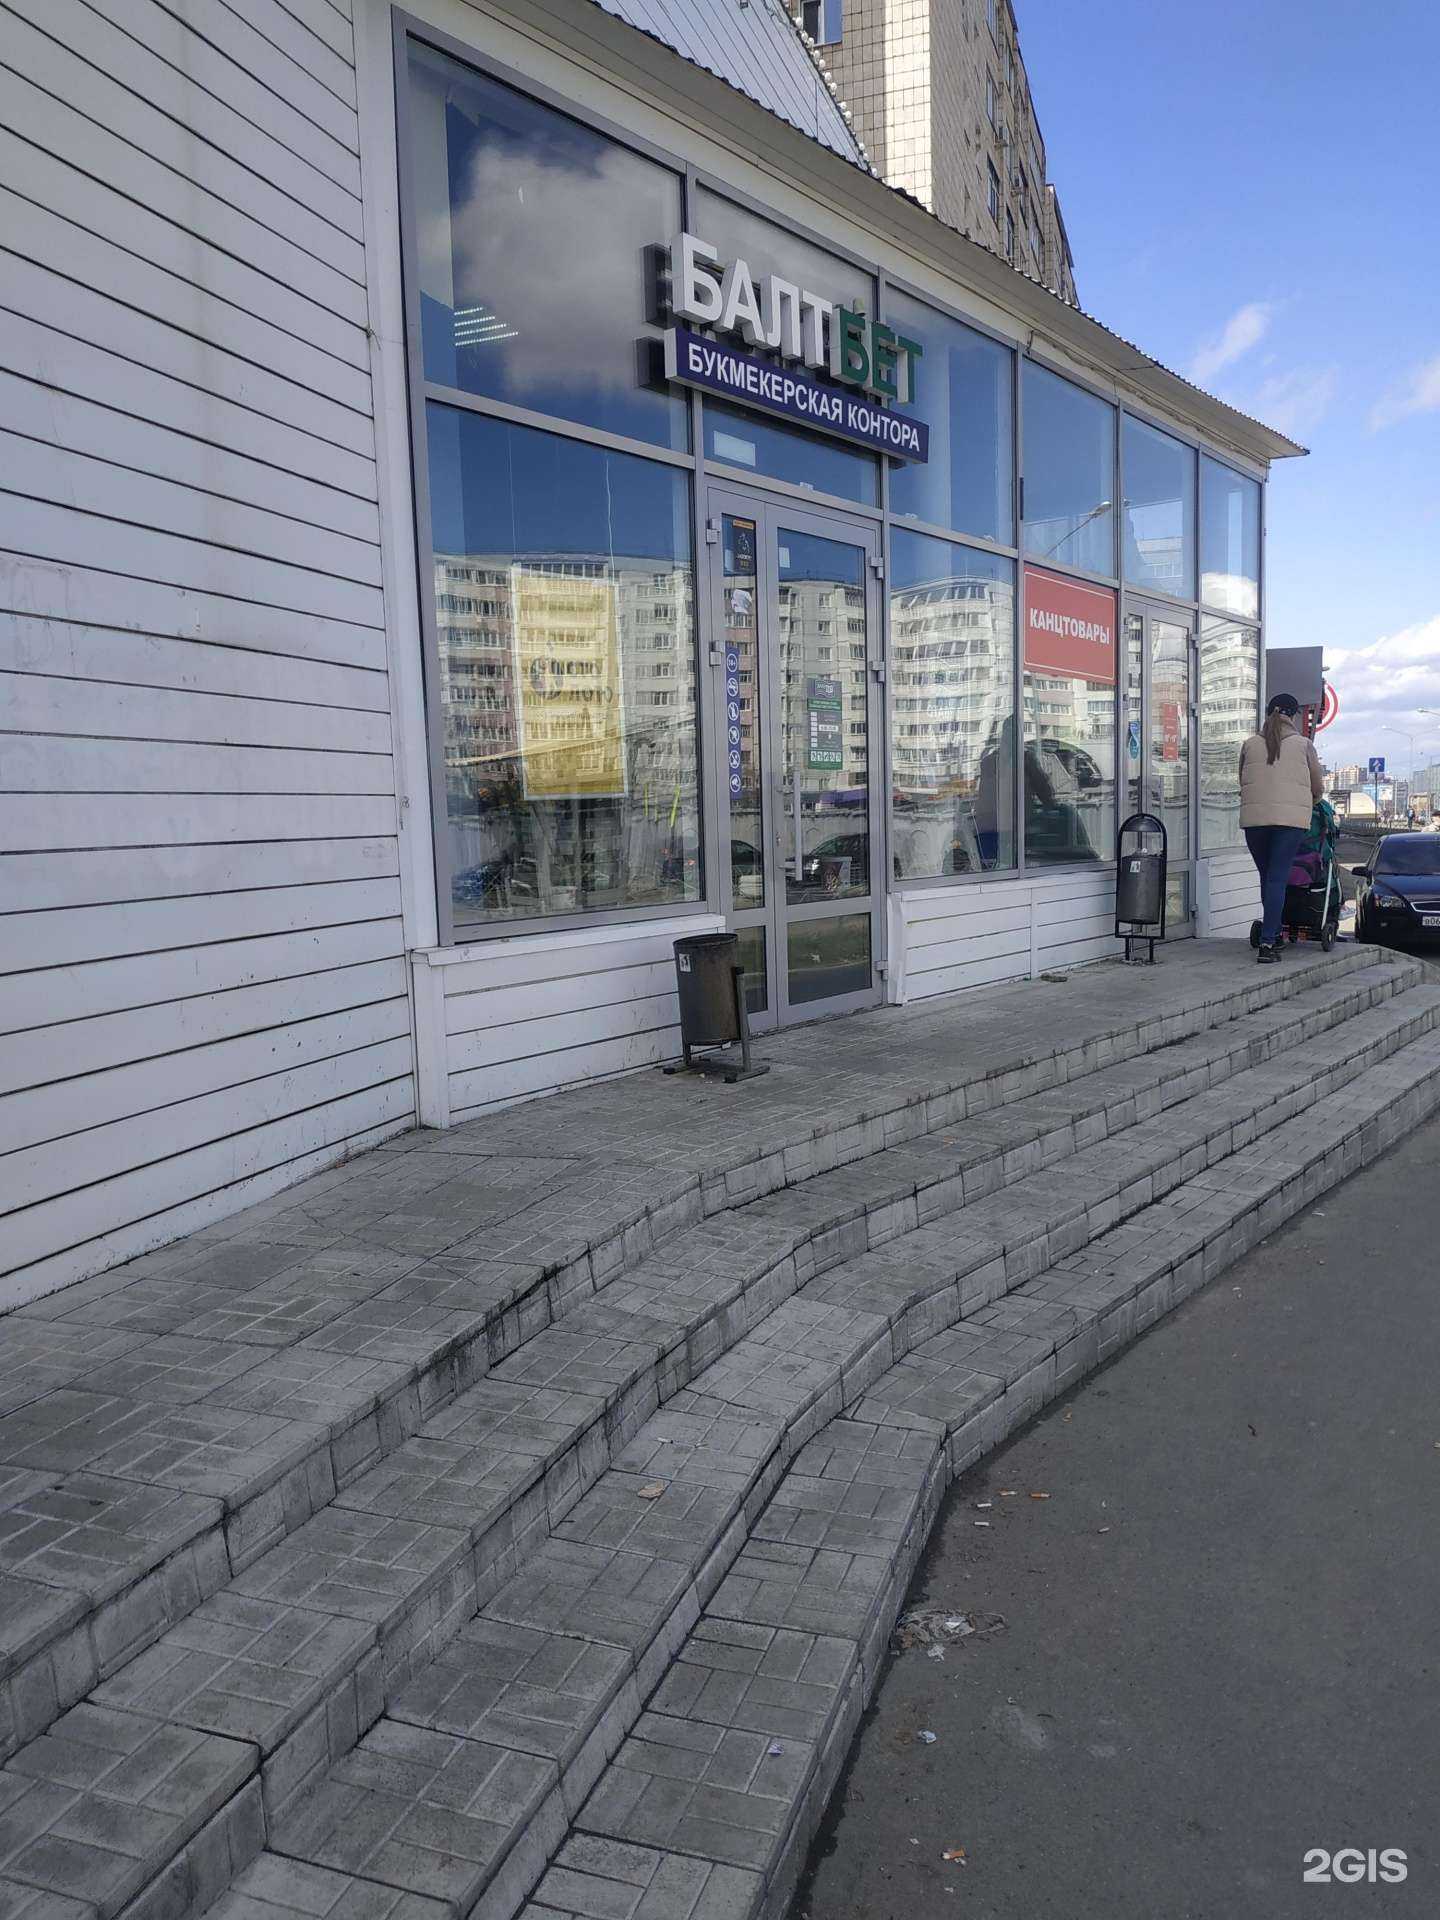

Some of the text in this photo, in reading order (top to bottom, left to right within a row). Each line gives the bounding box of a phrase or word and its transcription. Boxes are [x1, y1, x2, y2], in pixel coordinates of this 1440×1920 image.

[673, 232, 923, 404] БАЛТБЕТ
[688, 342, 921, 452] БУКМЕКЕРСКАЯ КОНТОРА
[1029, 607, 1111, 645] КАНЦТОВАРЫ
